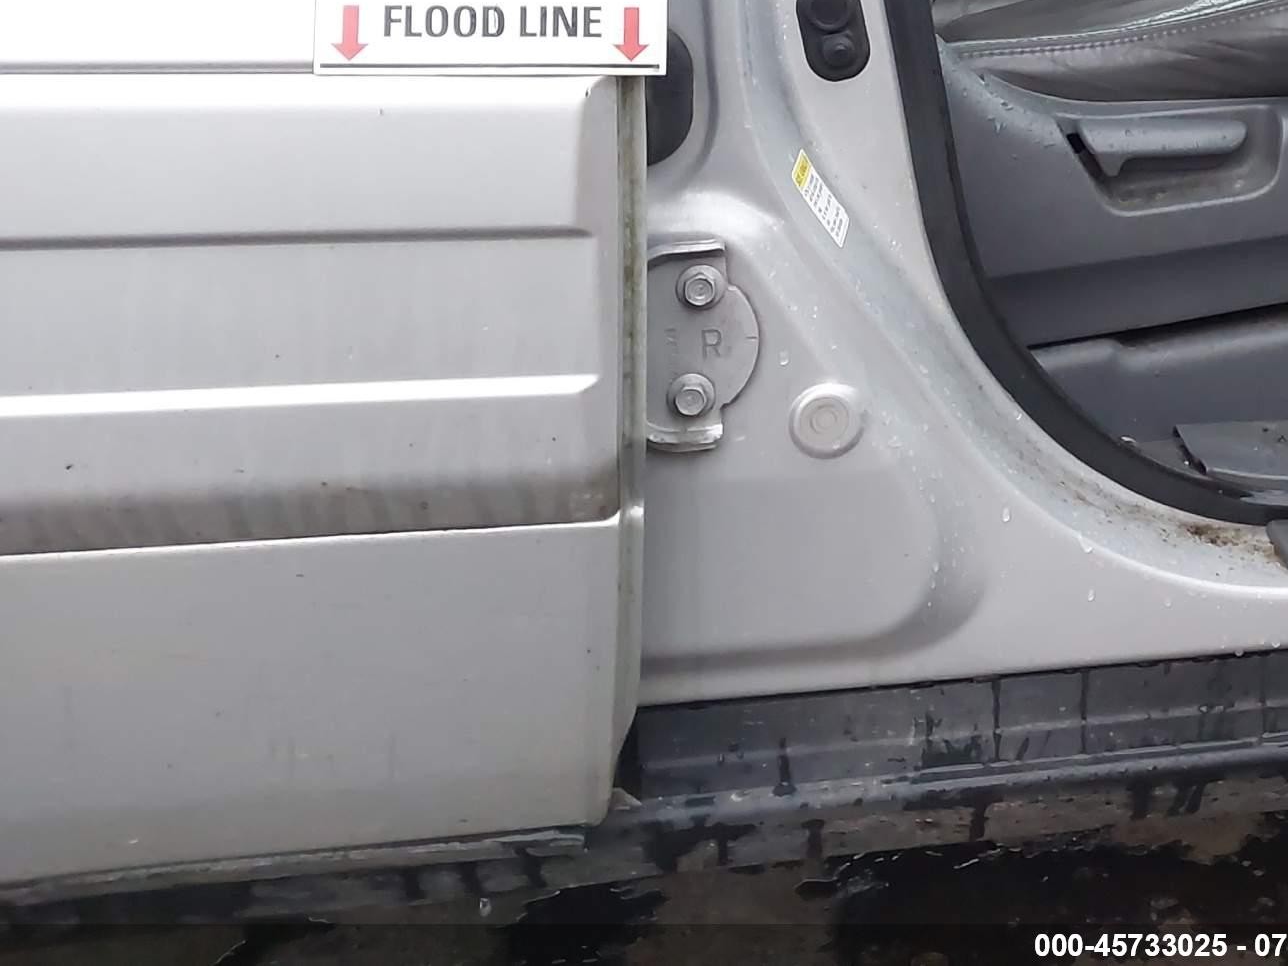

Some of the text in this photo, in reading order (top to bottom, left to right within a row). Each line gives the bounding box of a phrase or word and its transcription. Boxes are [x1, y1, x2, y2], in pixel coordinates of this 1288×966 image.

[383, 5, 603, 38] FLOOD LINE
[701, 329, 722, 359] R
